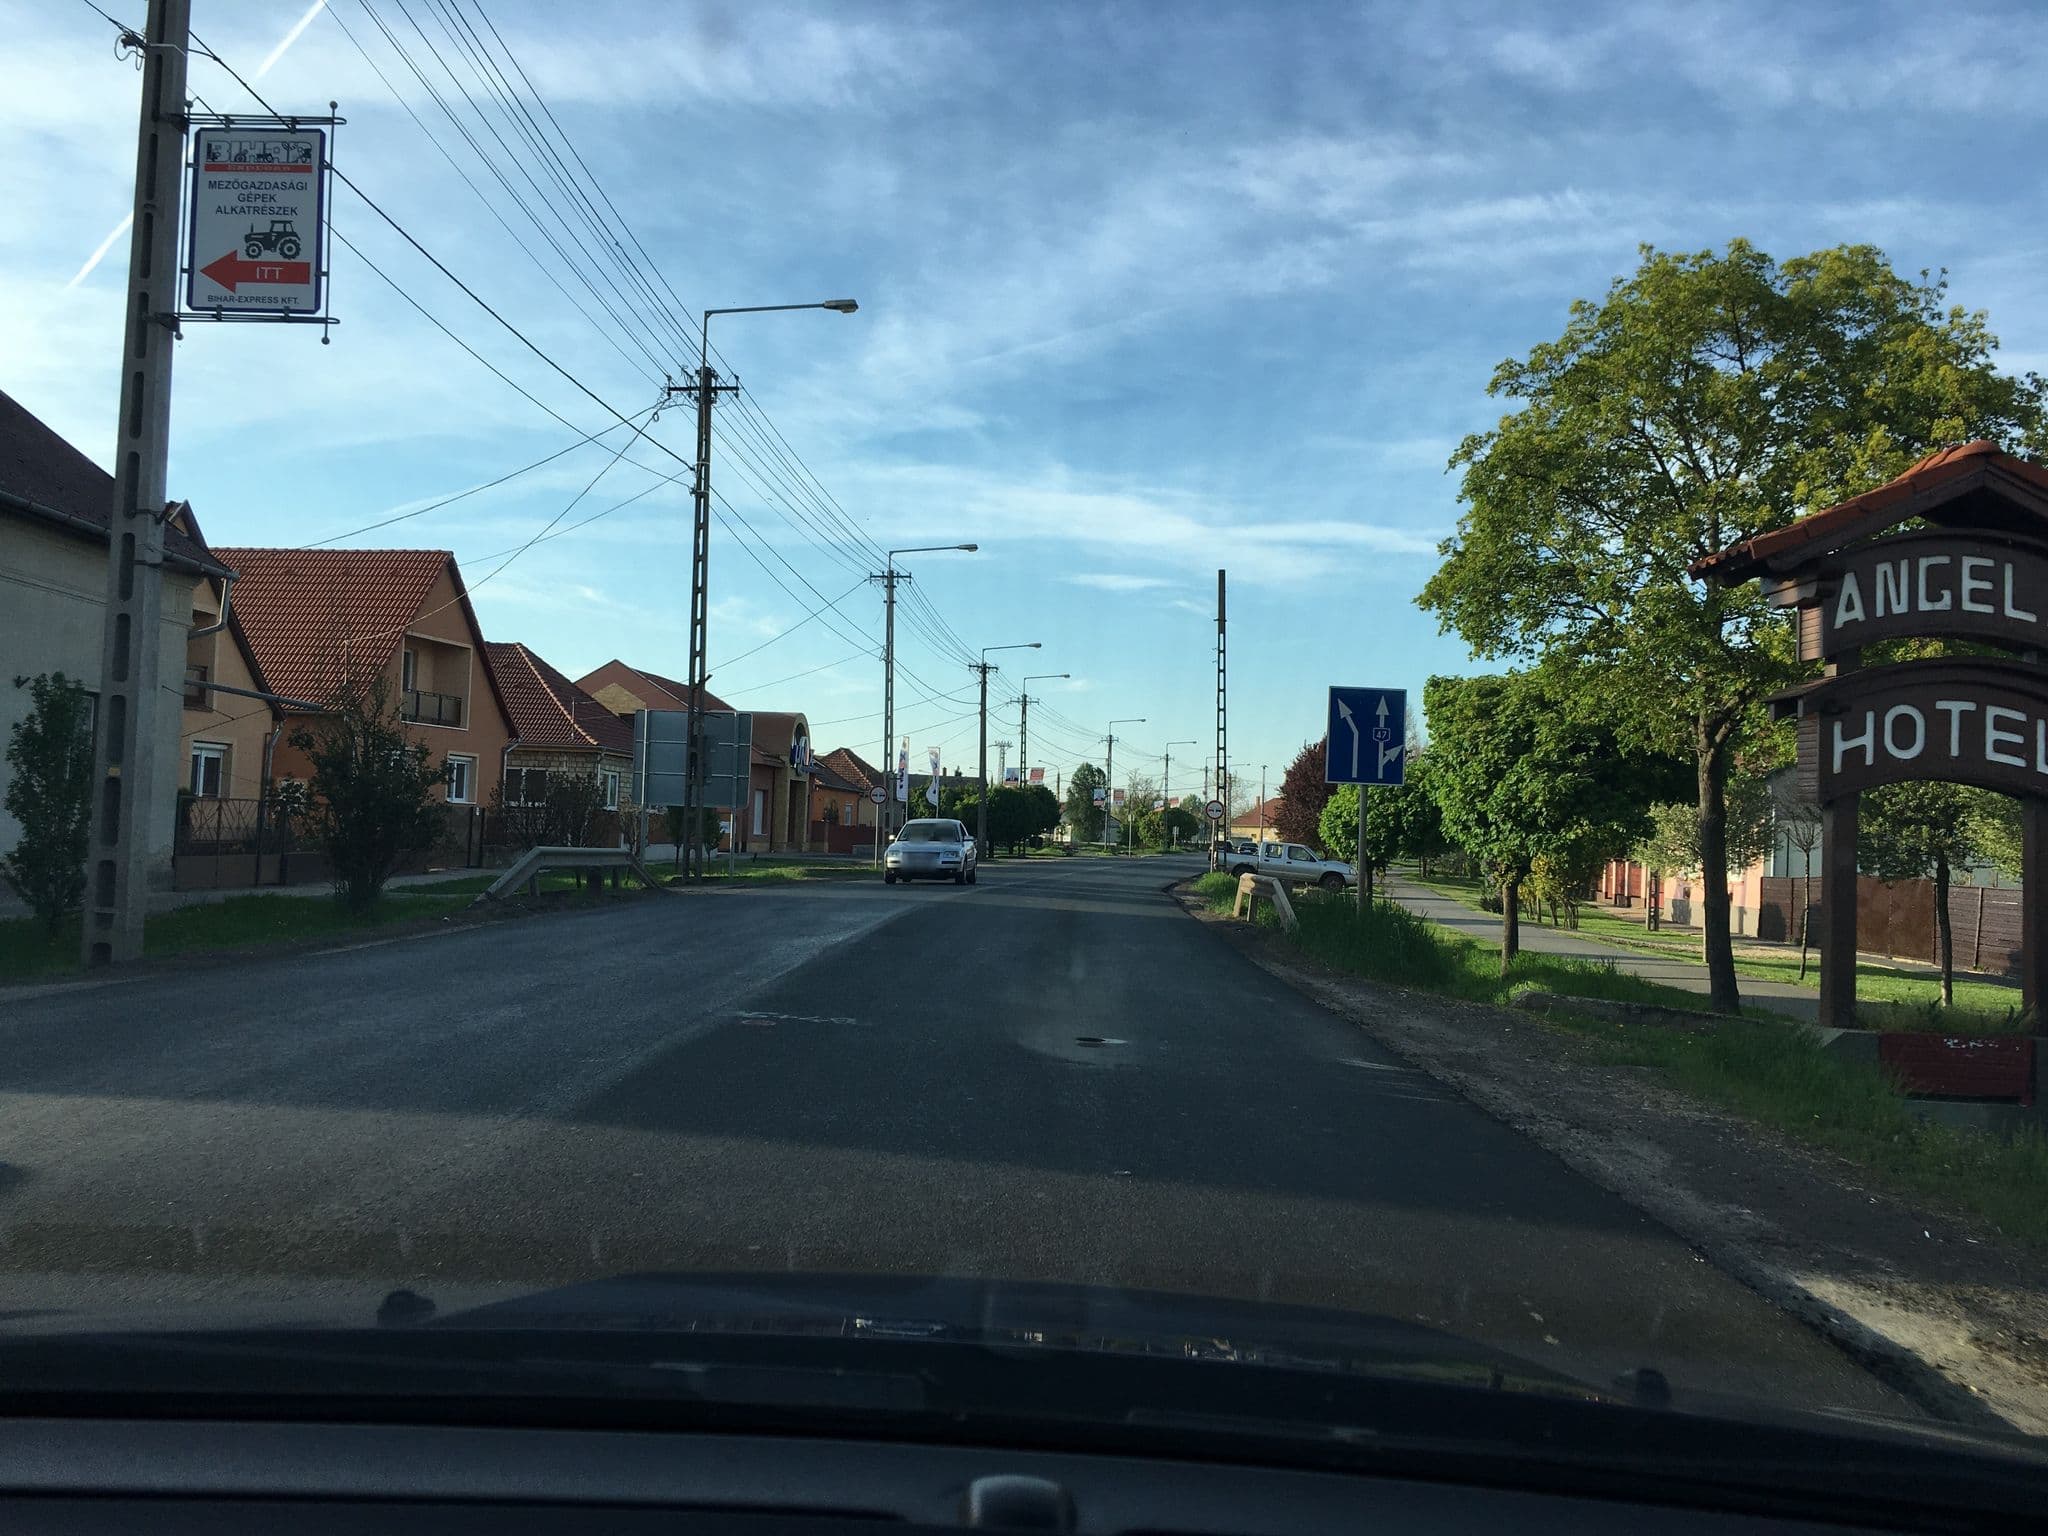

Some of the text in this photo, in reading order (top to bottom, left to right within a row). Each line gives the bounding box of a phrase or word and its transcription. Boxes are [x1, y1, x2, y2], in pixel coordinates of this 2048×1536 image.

[238, 192, 277, 203] GÉPEK
[215, 204, 298, 216] ALKATRÉSZEK
[256, 267, 283, 279] ITT
[207, 294, 278, 304] BIHAR-EXPRESS
[1834, 555, 2037, 630] ANGEL
[1376, 731, 1387, 739] 47
[1833, 700, 2048, 774] HOTEL
